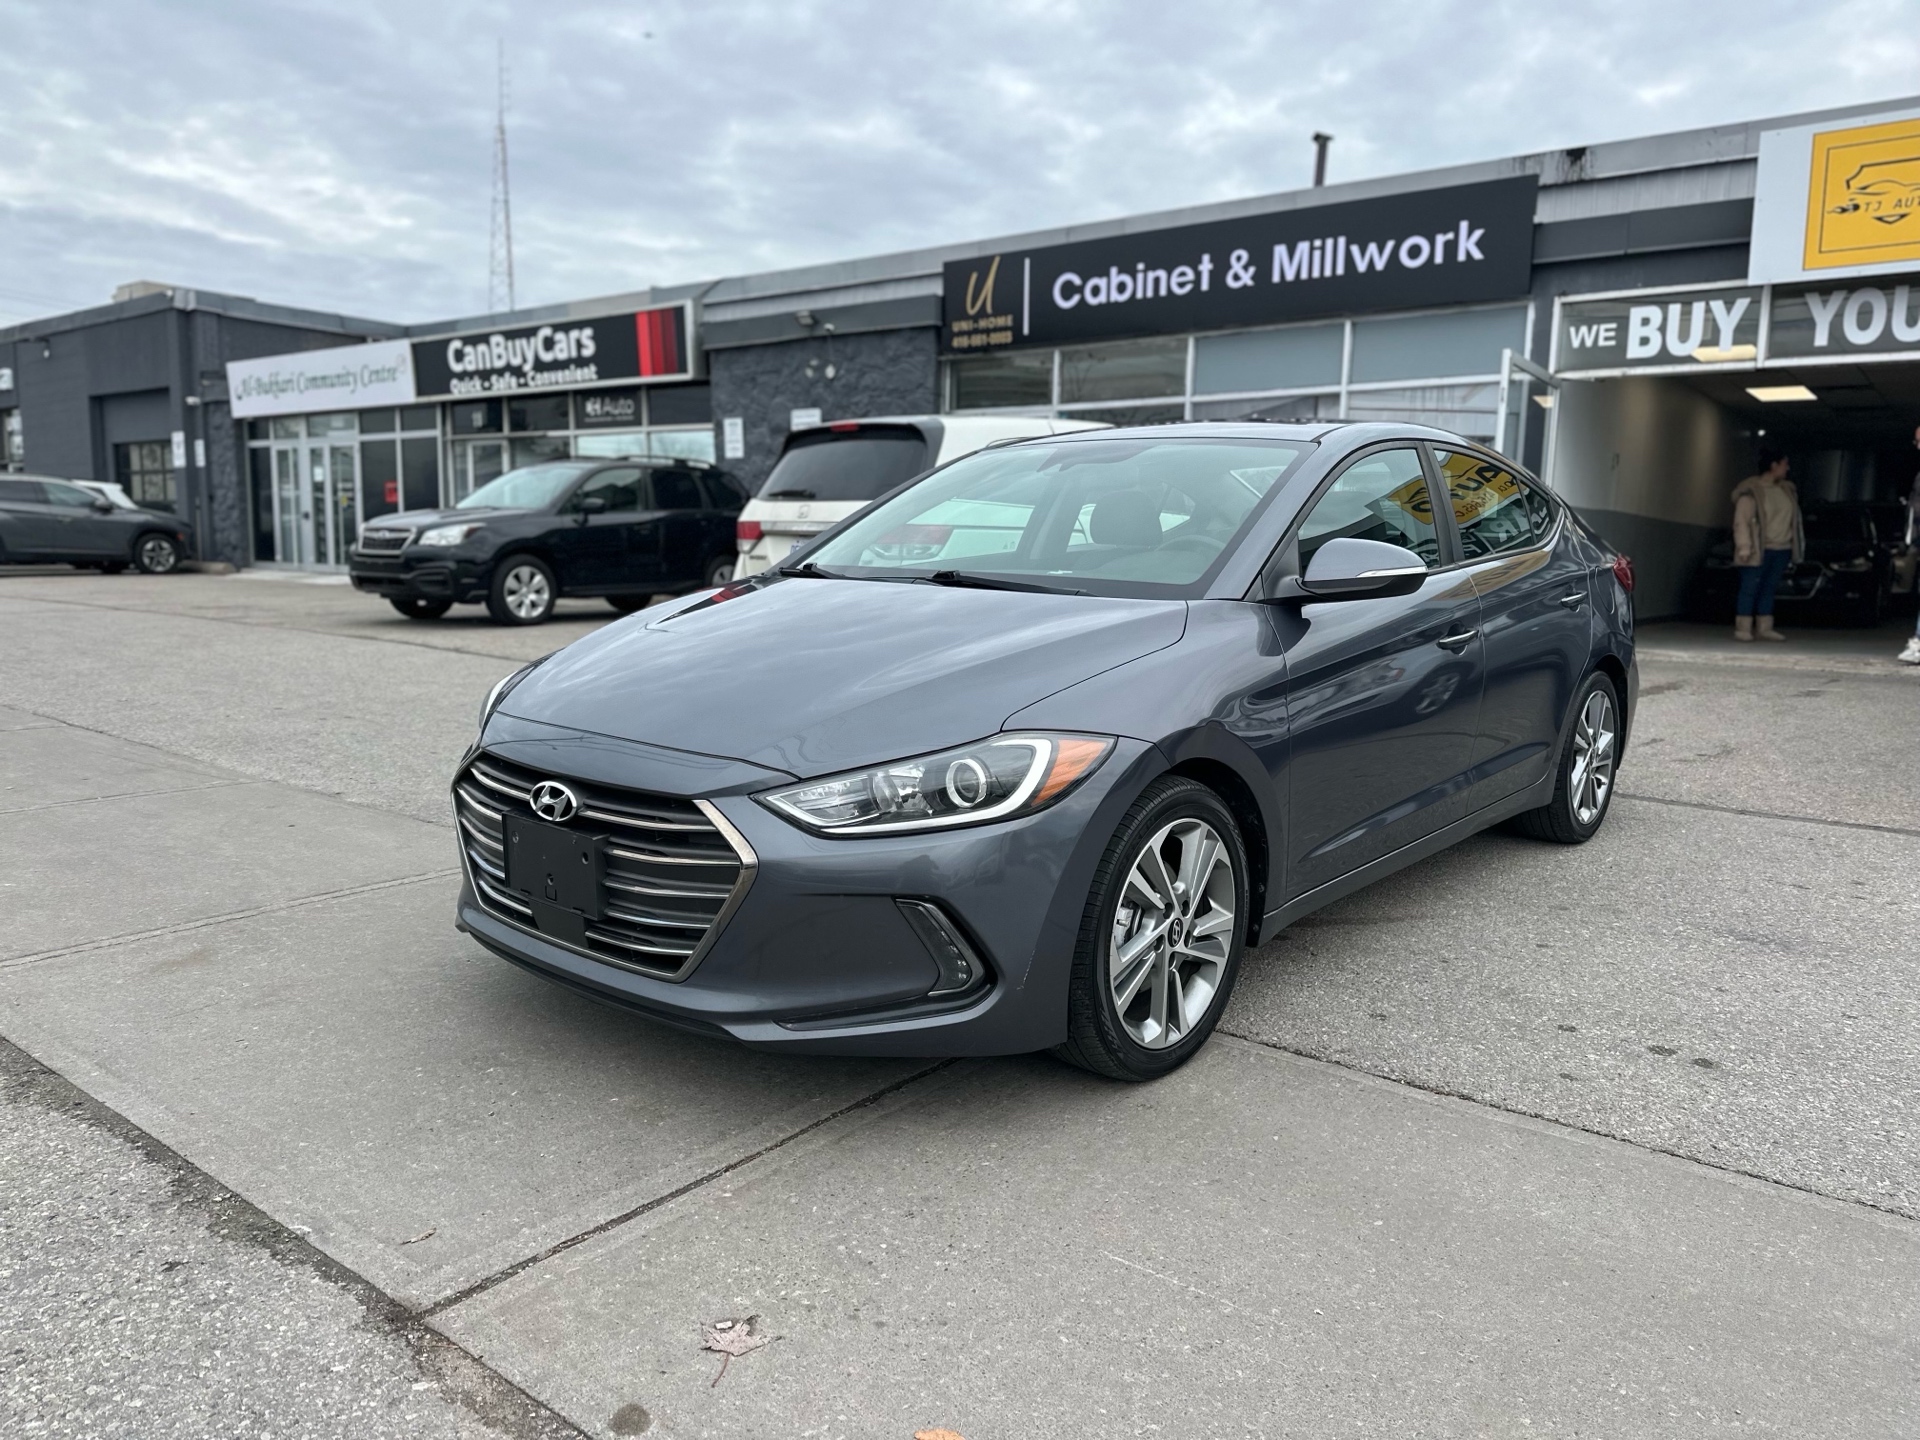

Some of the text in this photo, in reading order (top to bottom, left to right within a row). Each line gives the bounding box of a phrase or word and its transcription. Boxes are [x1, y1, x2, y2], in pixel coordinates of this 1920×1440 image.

[1863, 200, 1883, 213] TJ
[1052, 219, 1486, 310] Cabinet & Millwork
[952, 314, 1014, 333] UNI-HOME
[1569, 297, 1752, 360] WE BUY
[446, 326, 597, 373] CanBuyCars
[296, 363, 359, 394] Community
[360, 364, 397, 388] Centre
[449, 363, 599, 395] Quick Safe Convenient
[602, 397, 635, 415] Auto
